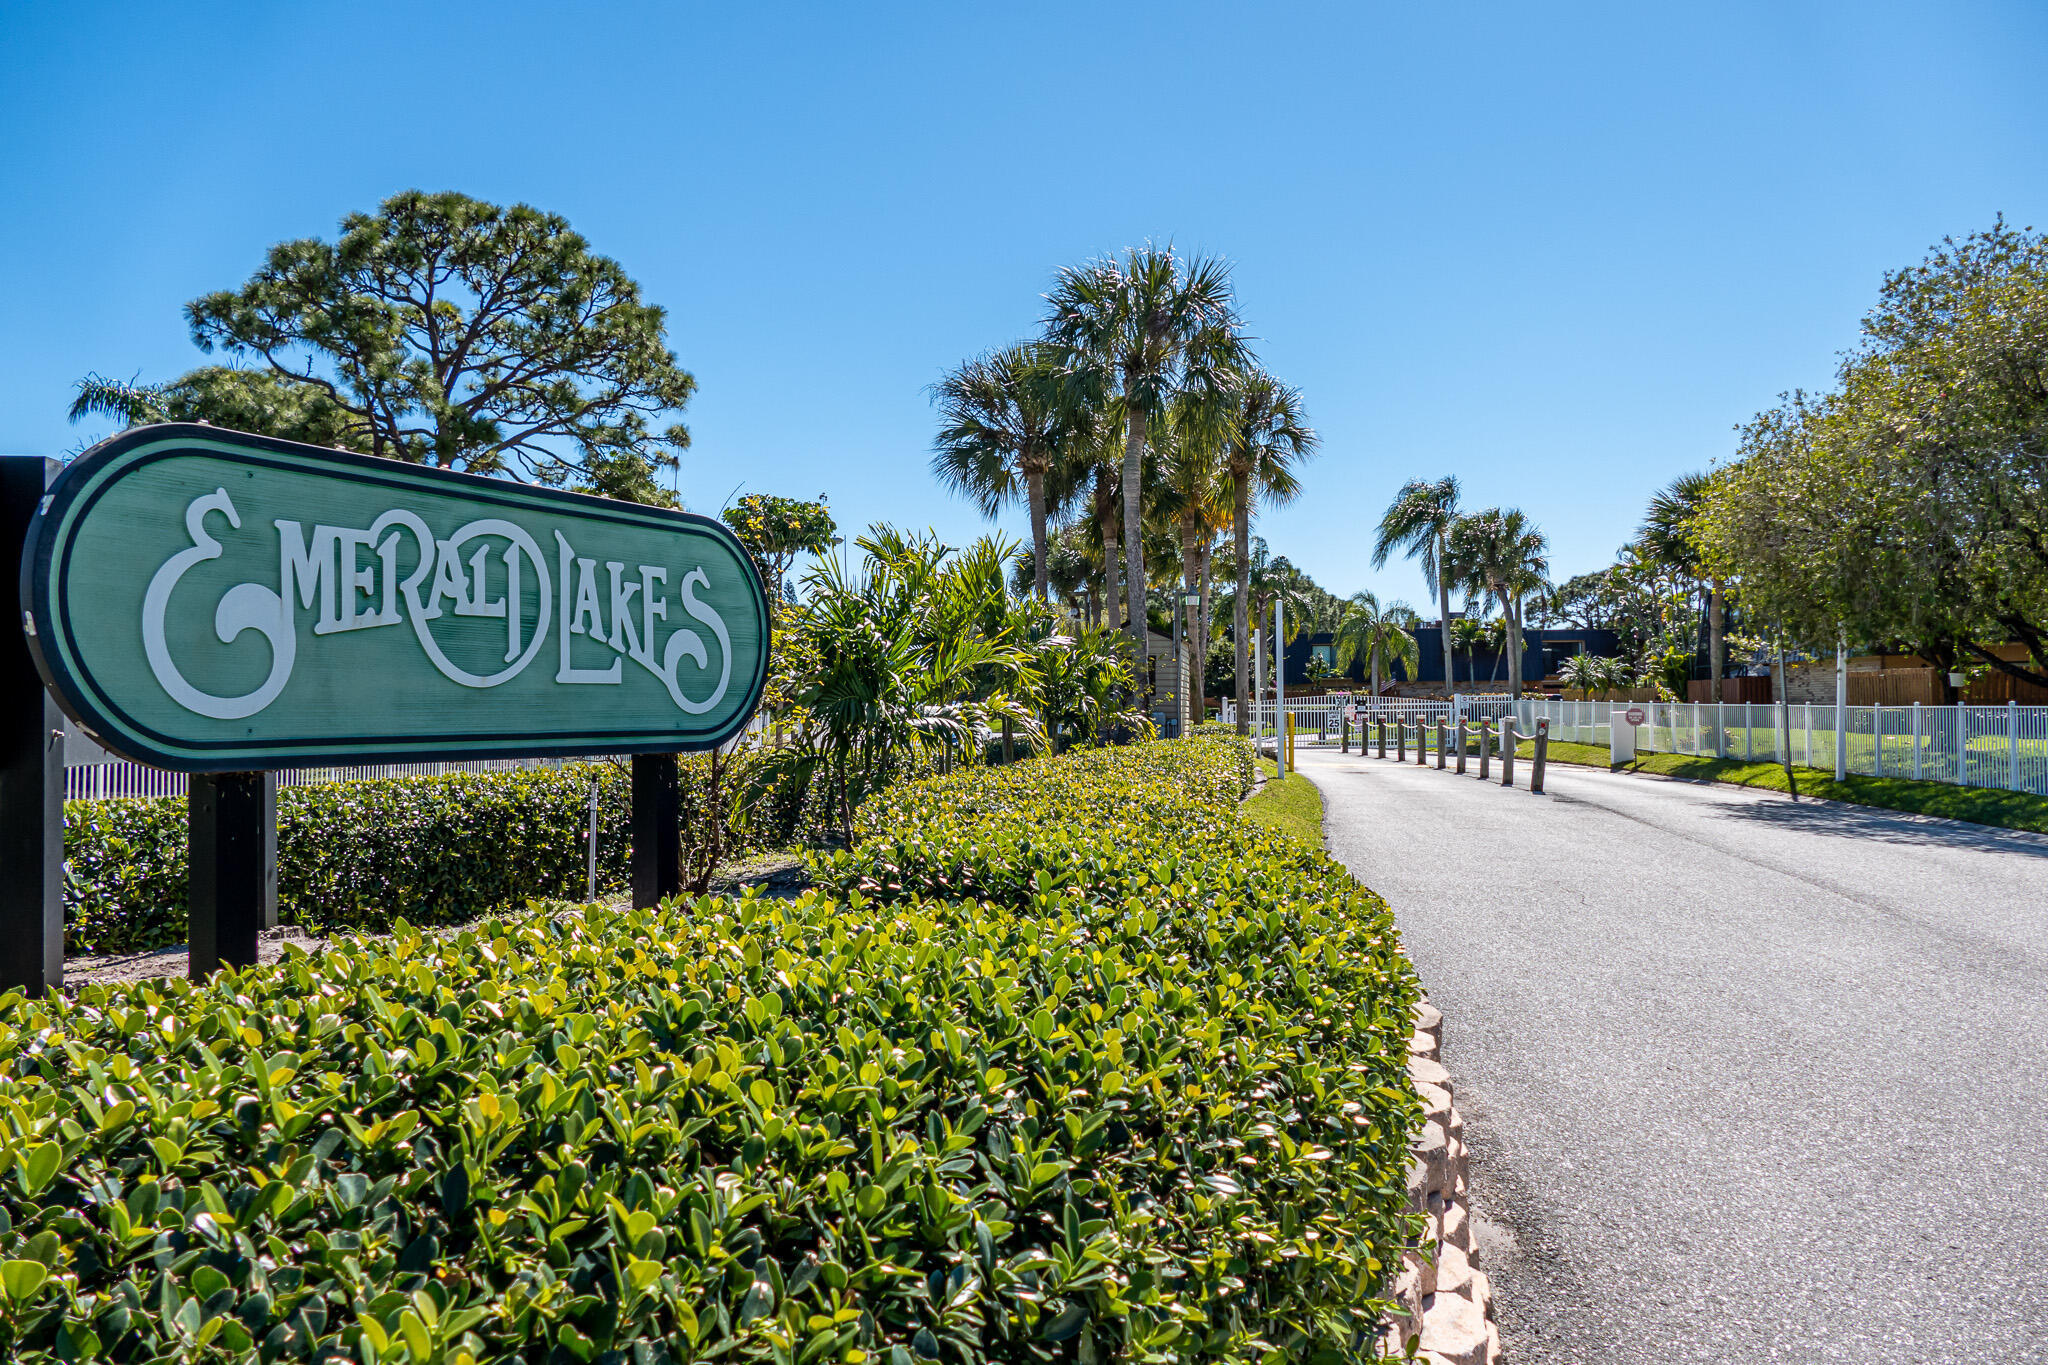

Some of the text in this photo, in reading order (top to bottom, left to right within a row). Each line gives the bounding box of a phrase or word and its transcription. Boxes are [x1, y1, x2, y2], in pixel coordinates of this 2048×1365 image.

[142, 487, 731, 719] EMERALD LAKES
[1329, 719, 1340, 727] 25
